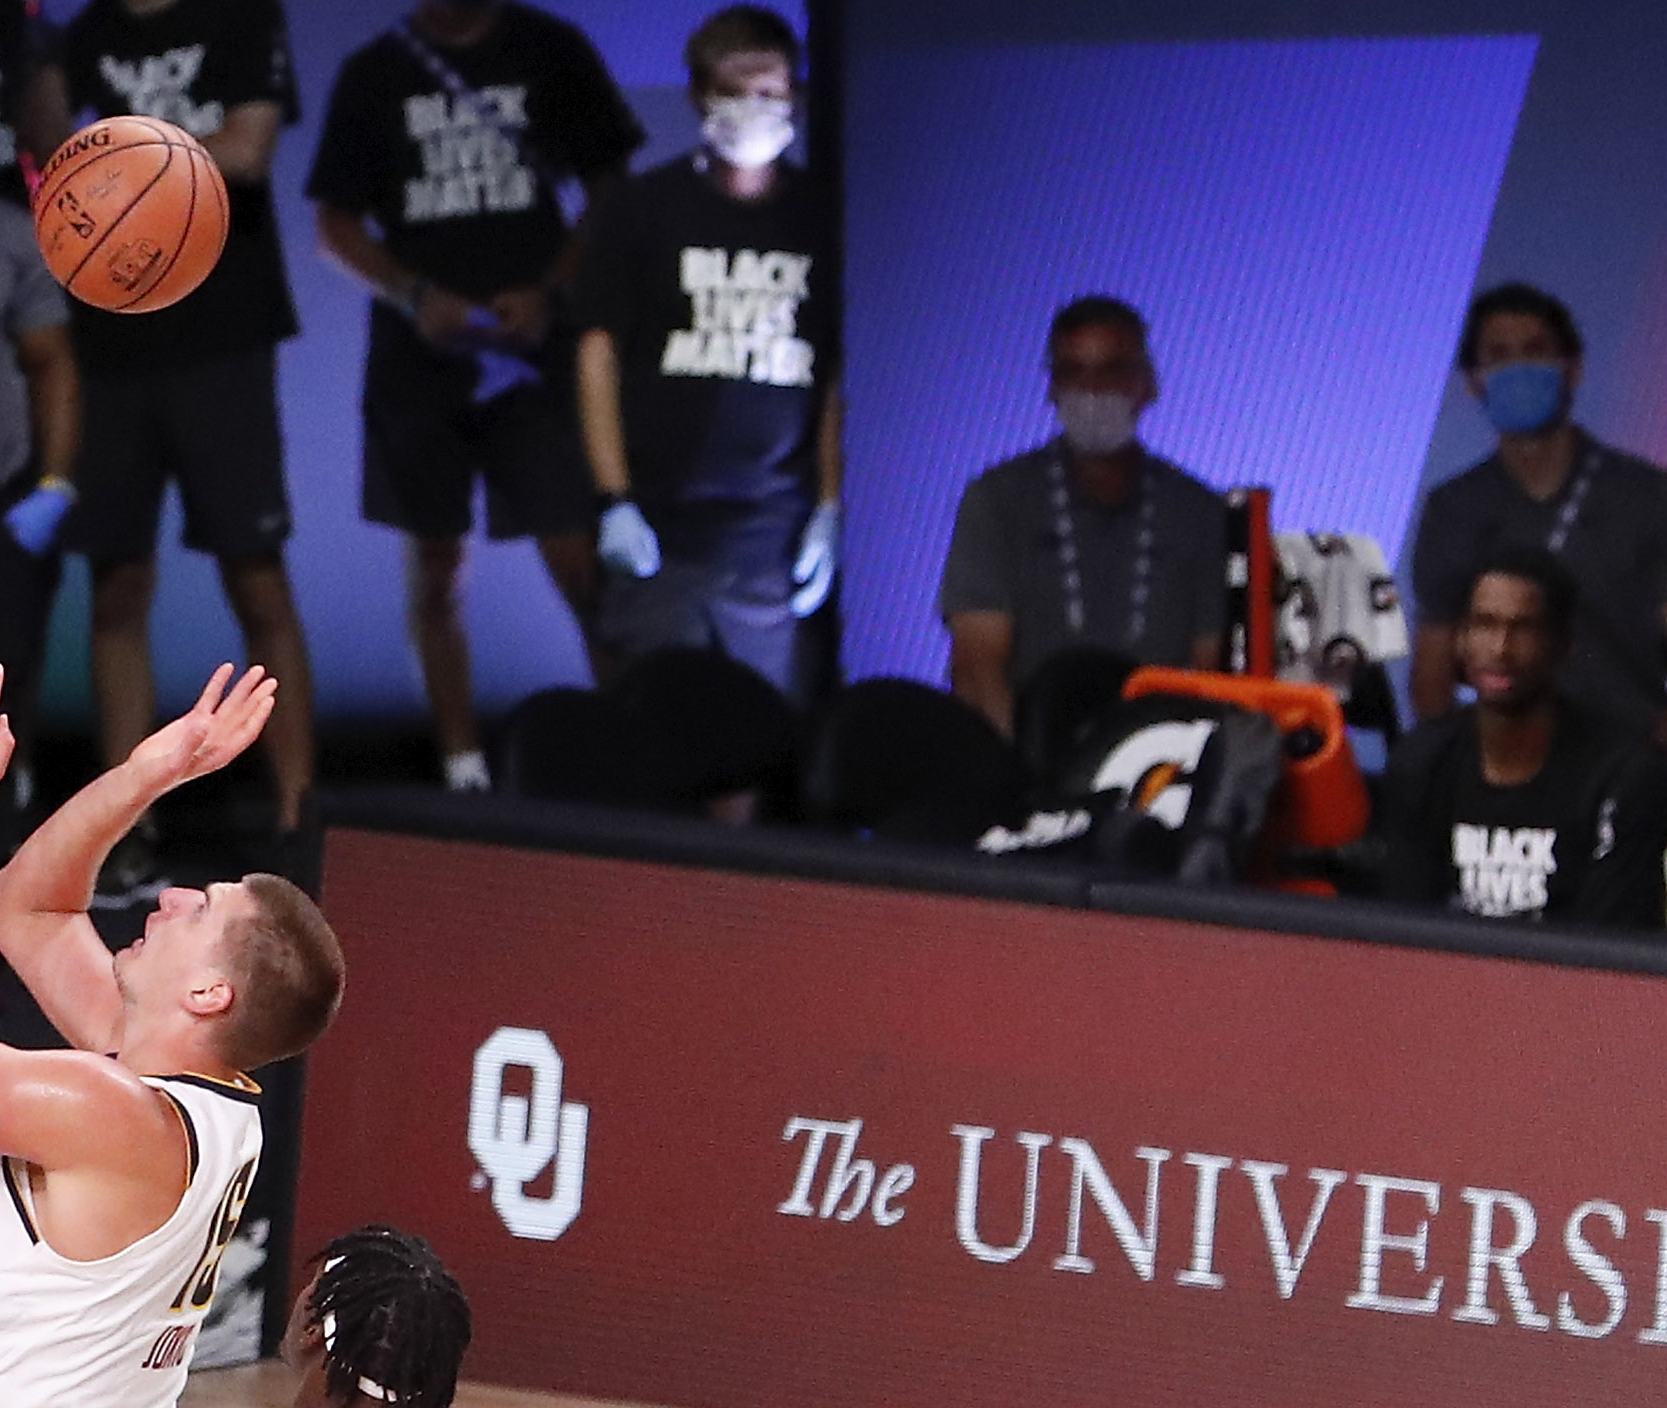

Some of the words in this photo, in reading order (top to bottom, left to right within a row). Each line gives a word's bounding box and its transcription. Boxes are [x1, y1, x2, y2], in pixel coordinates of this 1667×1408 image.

[678, 246, 813, 300] BLACK
[1452, 821, 1558, 874] BLACK
[1459, 863, 1548, 918] LIVES
[468, 1025, 589, 1242] OU
[776, 1115, 916, 1227] The
